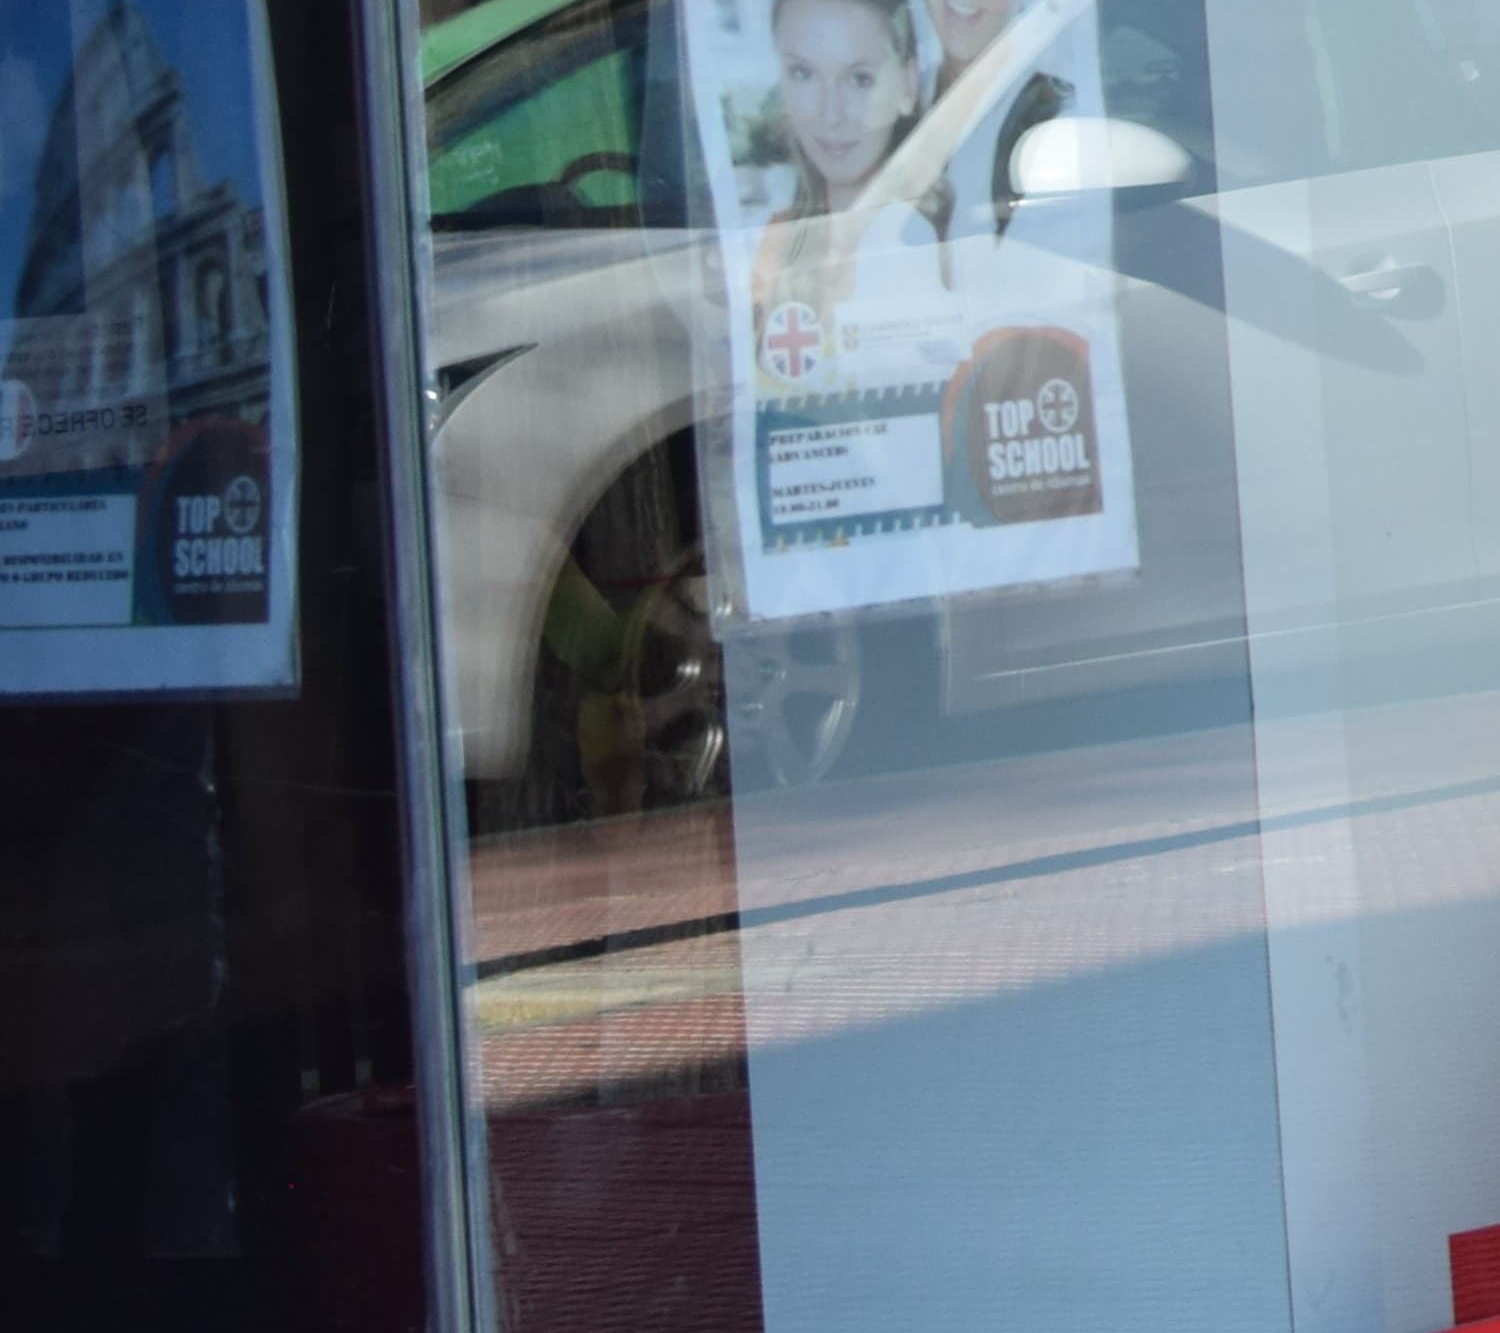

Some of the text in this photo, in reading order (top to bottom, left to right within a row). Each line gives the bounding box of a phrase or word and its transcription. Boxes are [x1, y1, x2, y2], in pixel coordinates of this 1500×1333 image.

[983, 399, 1035, 439] TOP
[987, 432, 1091, 481] SCHOOL
[177, 495, 221, 534] TOP
[174, 536, 265, 577] SCHOOL
